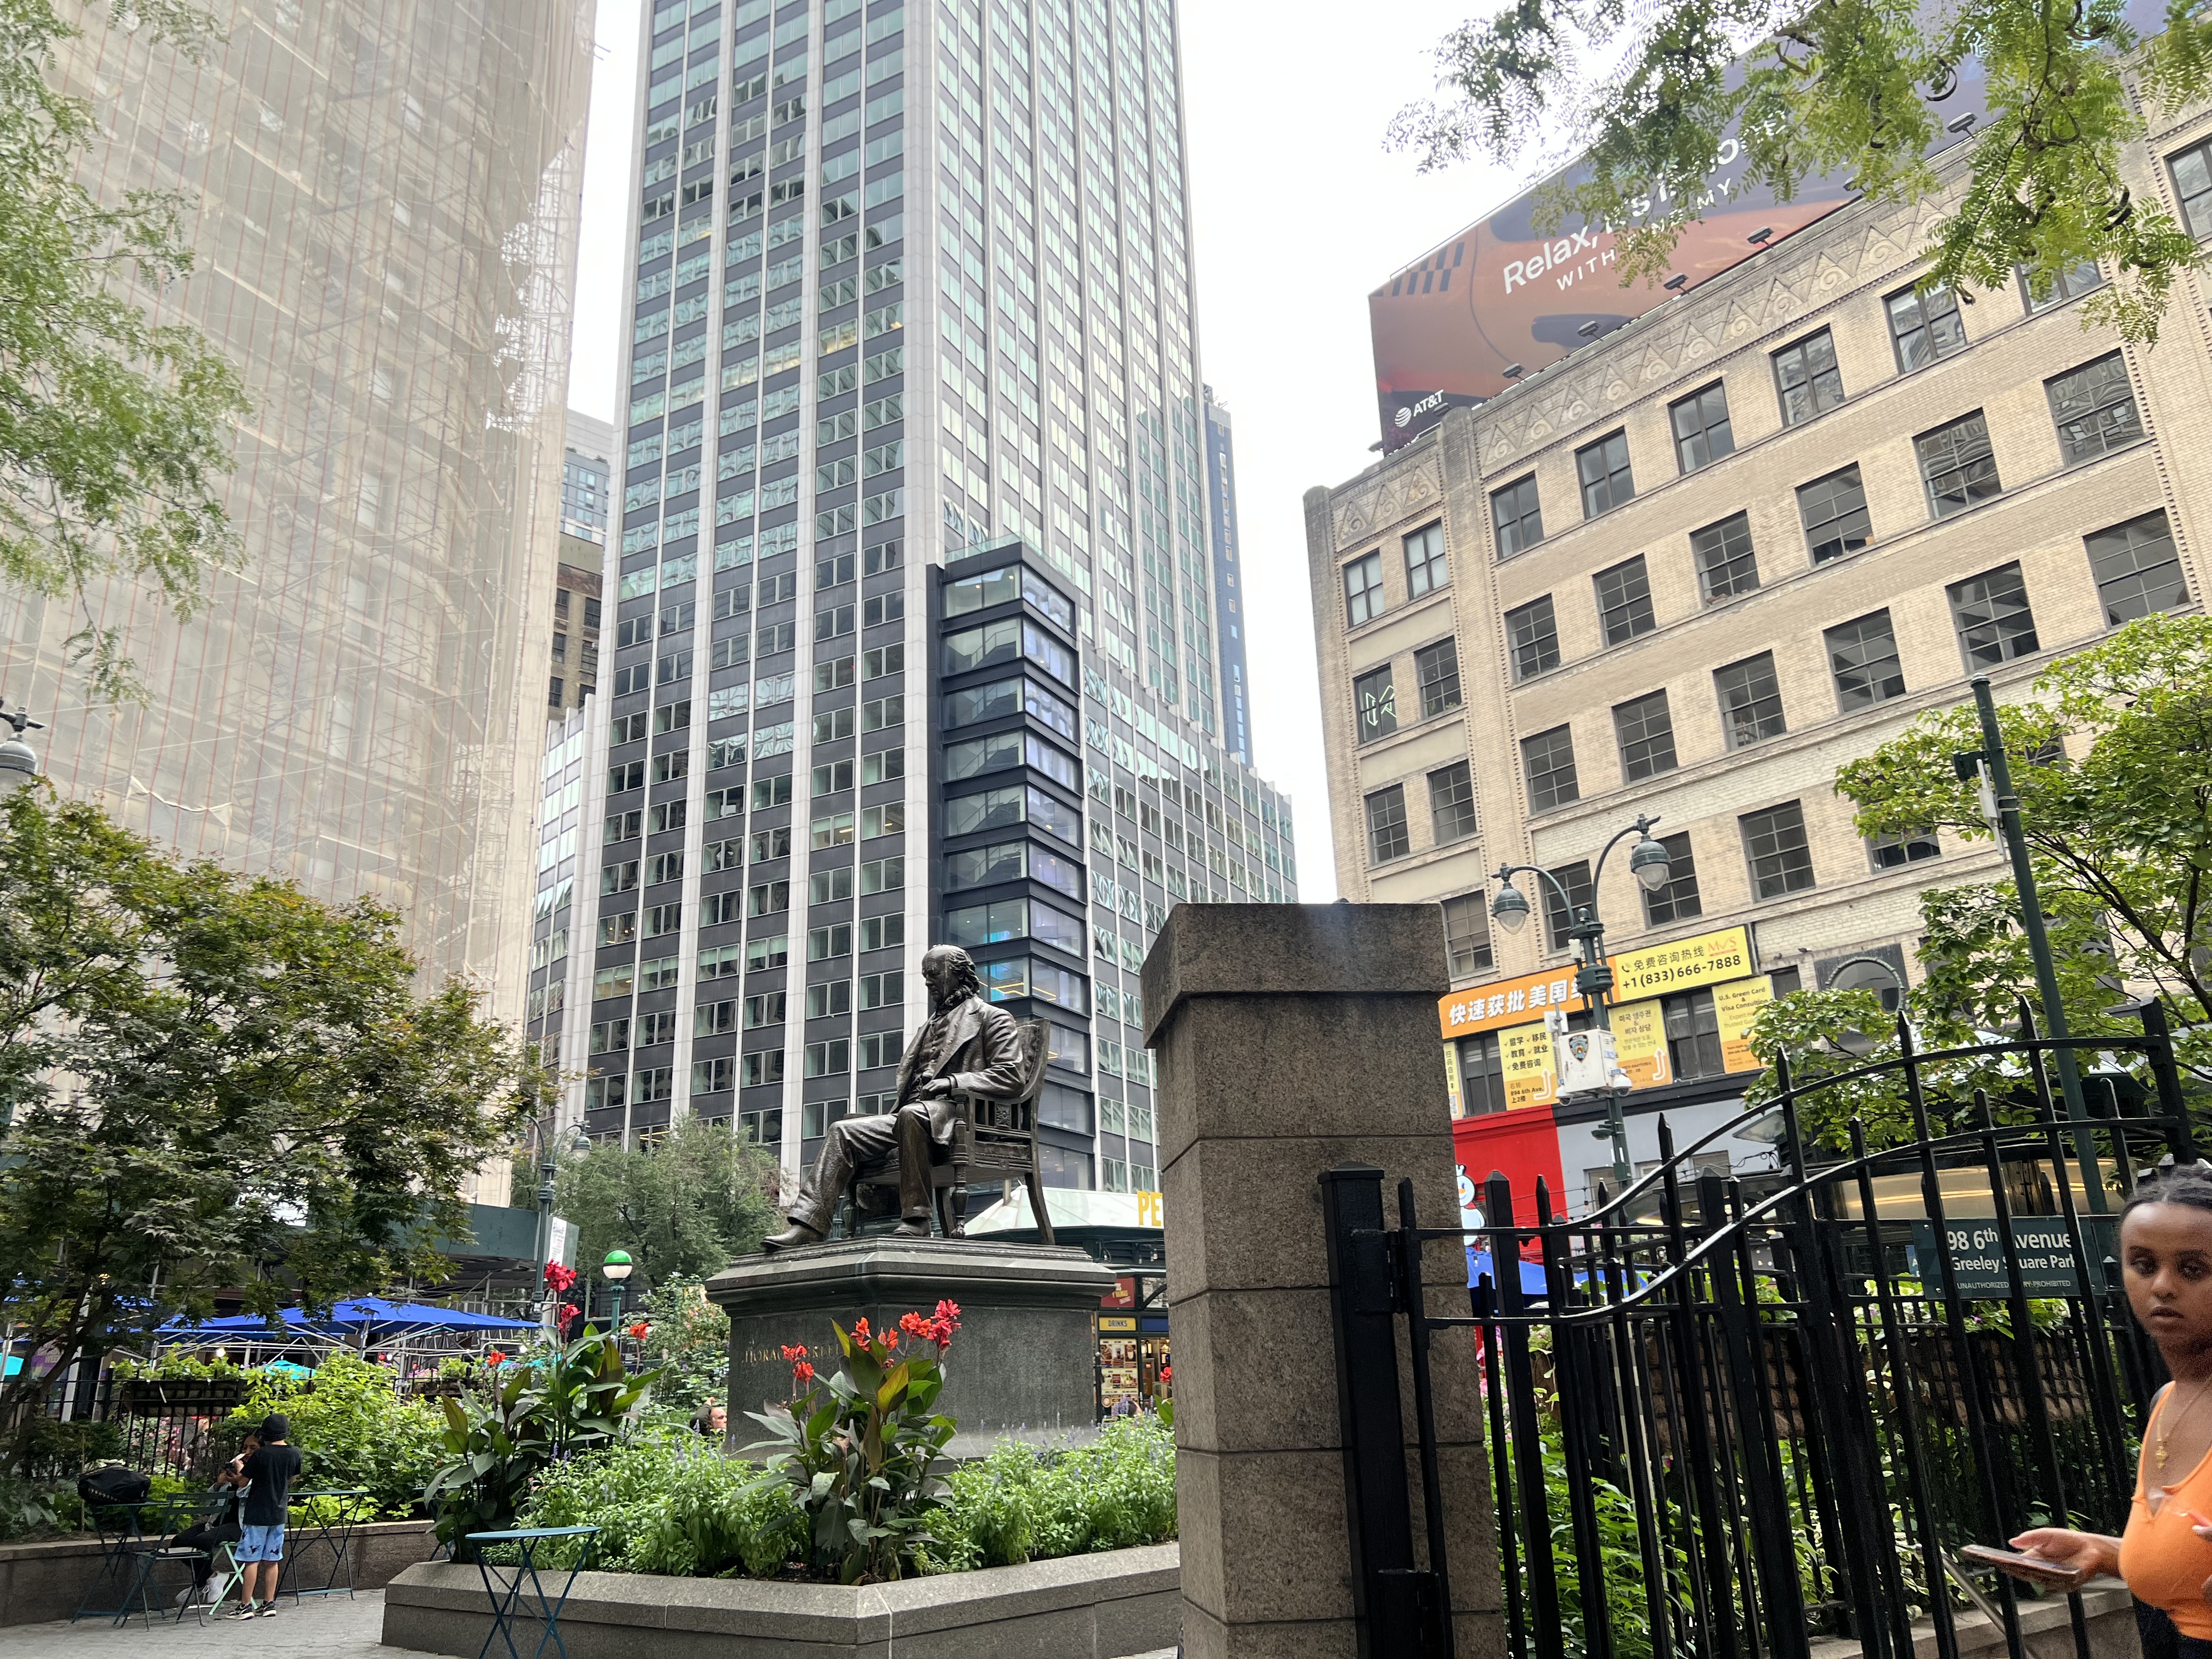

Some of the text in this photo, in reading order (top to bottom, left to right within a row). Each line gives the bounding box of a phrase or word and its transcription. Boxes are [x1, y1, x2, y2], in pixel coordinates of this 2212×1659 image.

[1502, 225, 1598, 295] Relax,
[1556, 249, 1616, 291] WITH
[1413, 389, 1444, 417] AT&T
[1633, 946, 1705, 972] 免费咨询热线
[1677, 955, 1741, 978] 666-7888
[1449, 977, 1583, 1026] 快速获批美国
[1732, 990, 1750, 998] Green
[1509, 1032, 1547, 1046] 留学 移民
[1511, 1044, 1549, 1058] 教育 就业
[1512, 1058, 1541, 1071] 免费咨询
[1946, 1227, 2072, 1250] 98 6th venue
[1951, 1255, 2000, 1274] Greeley
[1956, 1281, 2010, 1289] UNAUTHORIZED
